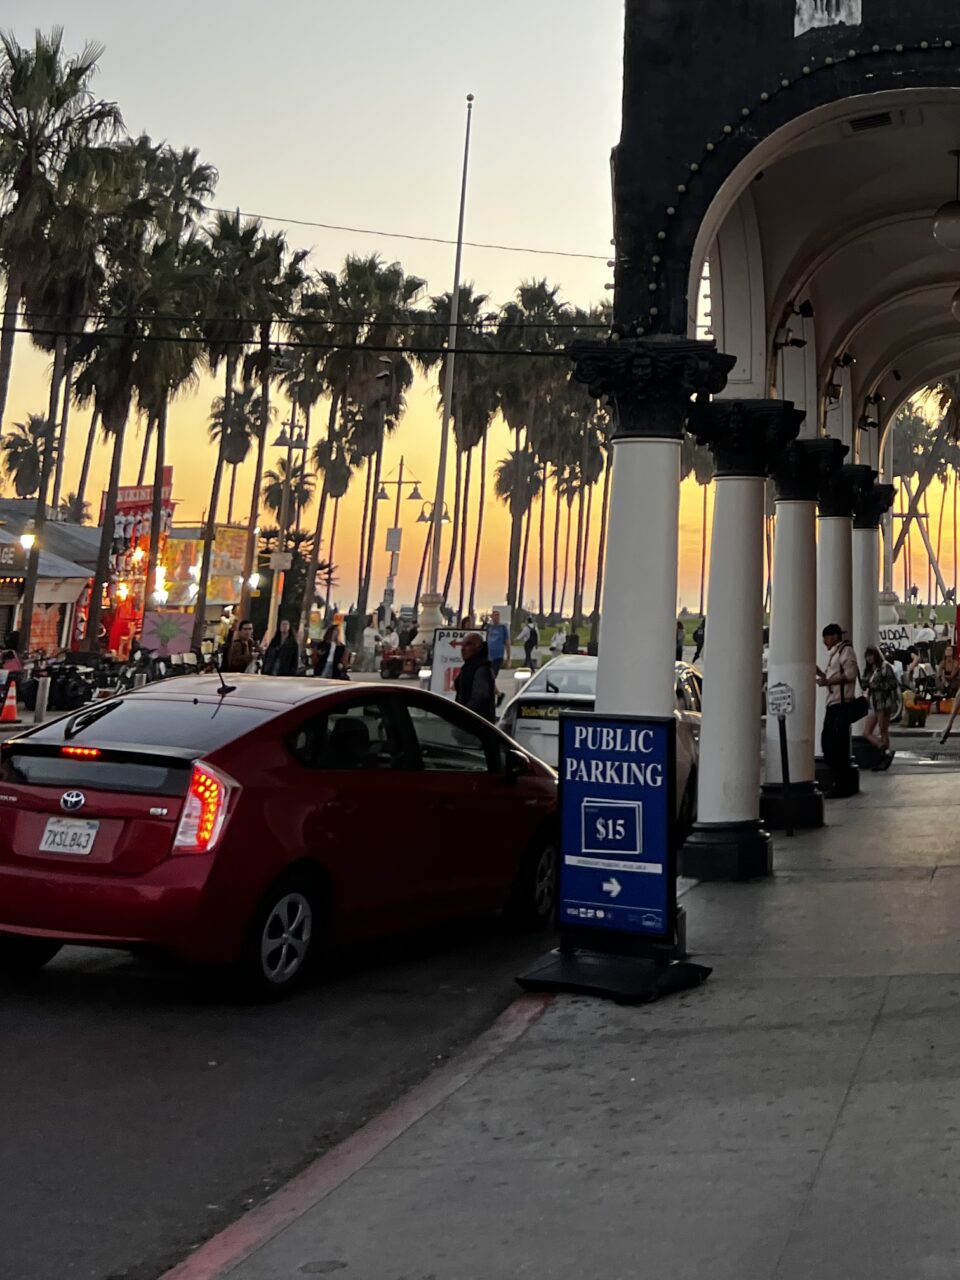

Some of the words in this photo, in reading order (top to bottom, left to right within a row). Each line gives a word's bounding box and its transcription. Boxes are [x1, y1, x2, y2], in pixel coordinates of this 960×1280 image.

[573, 725, 655, 753] PUBLIC
[565, 757, 664, 787] PARKING
[44, 829, 91, 849] 7XSL843
[596, 816, 625, 841] $15
